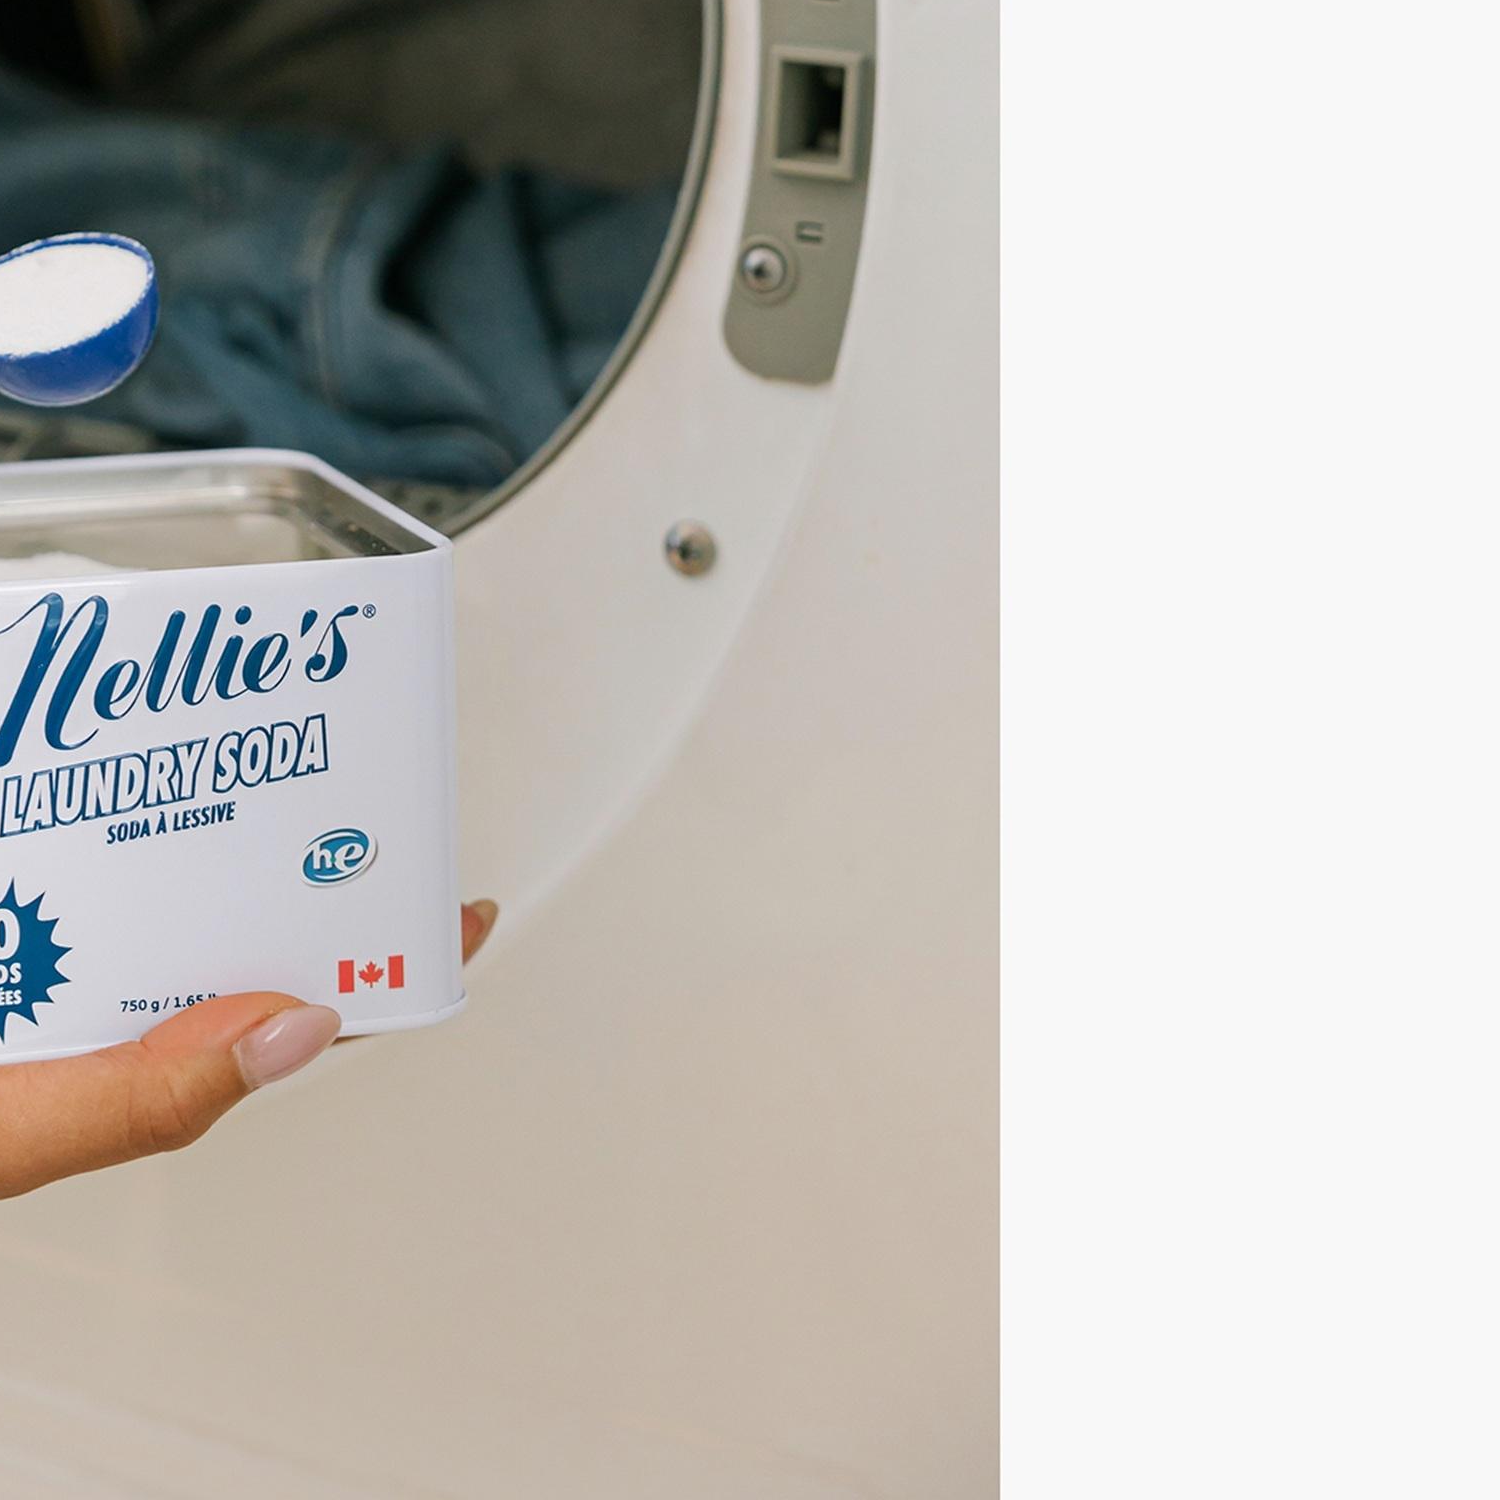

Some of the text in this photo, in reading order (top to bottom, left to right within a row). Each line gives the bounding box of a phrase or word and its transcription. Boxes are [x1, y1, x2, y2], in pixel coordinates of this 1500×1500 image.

[0, 713, 330, 838] LAUNDRY SODA
[106, 801, 236, 845] SODA À LESSIVE
[120, 999, 148, 1013] 750
[151, 1000, 160, 1013] g
[173, 994, 204, 1008] 1.65
